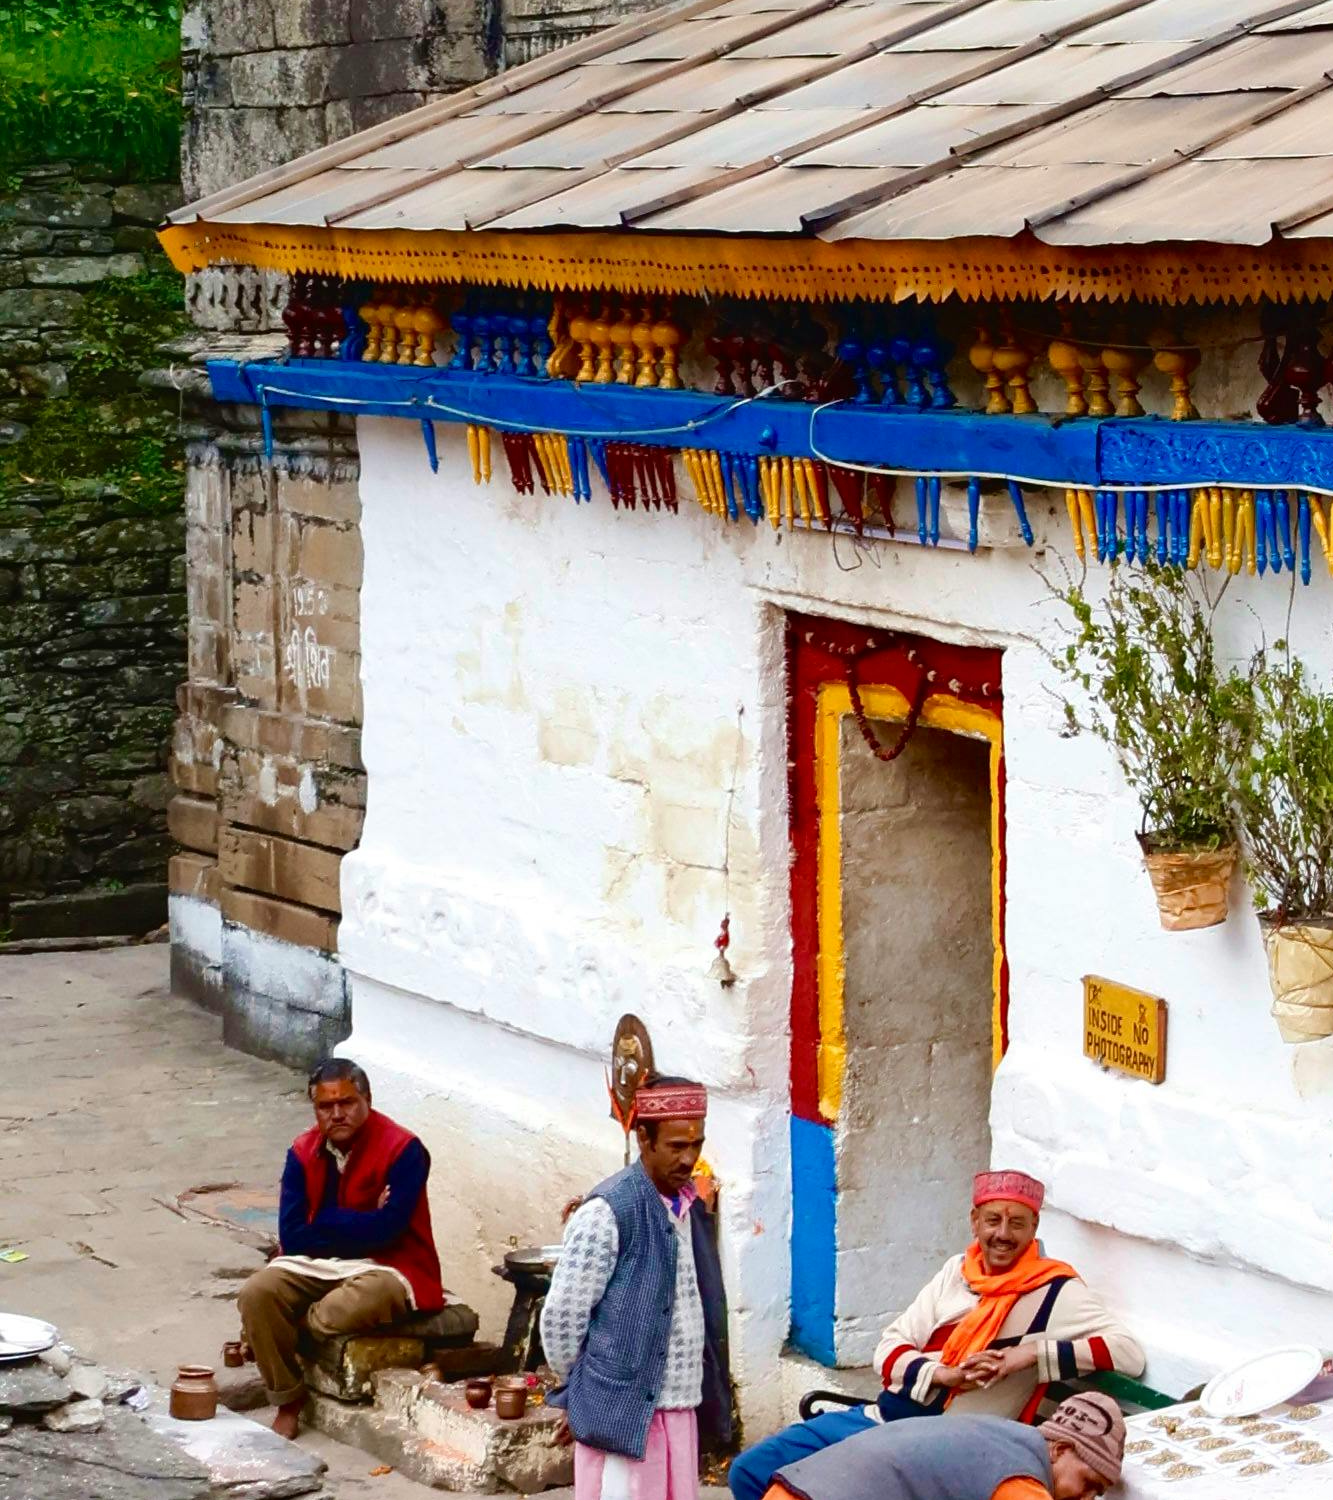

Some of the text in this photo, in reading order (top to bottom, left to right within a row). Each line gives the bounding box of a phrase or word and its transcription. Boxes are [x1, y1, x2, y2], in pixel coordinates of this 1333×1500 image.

[1089, 1007, 1148, 1045] INSIDE NO
[1087, 1032, 1154, 1077] PHOTOGRAPHY
